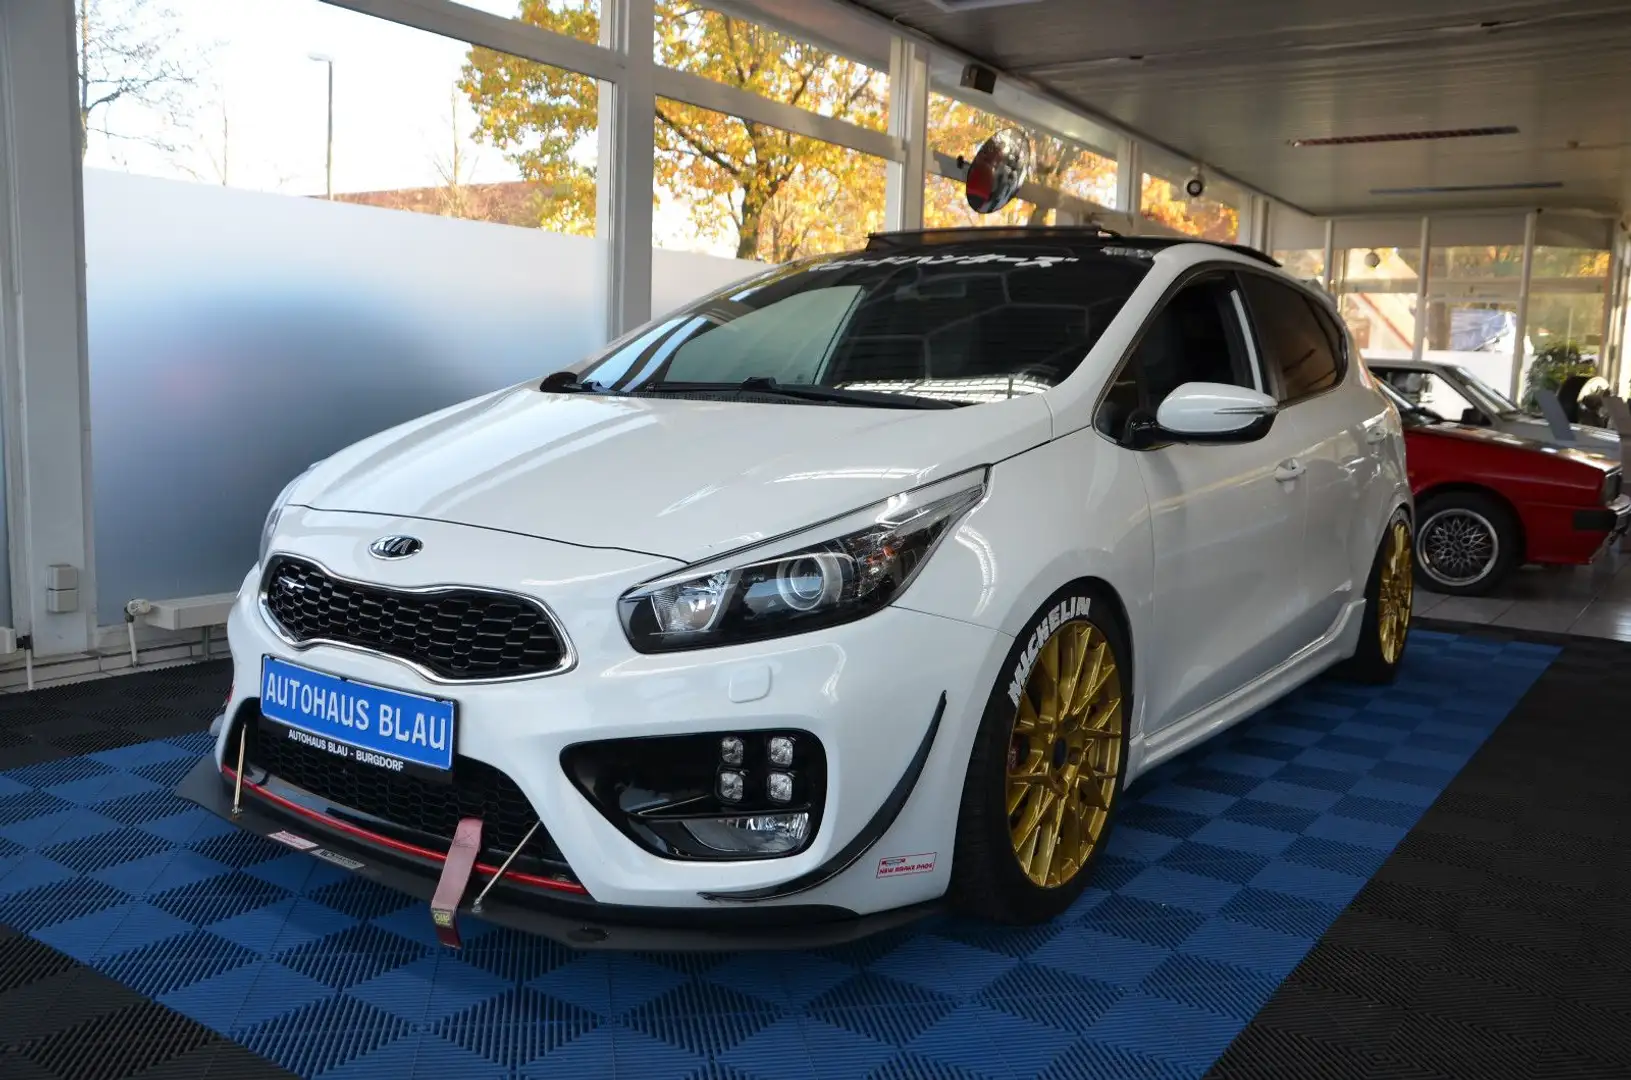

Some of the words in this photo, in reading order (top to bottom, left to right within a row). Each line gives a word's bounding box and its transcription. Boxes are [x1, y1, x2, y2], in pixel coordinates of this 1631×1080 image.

[372, 536, 413, 554] KIA
[1007, 596, 1091, 708] MICHELIN
[265, 672, 370, 731] AUTOHAUS
[378, 703, 447, 750] BLAU
[288, 729, 326, 750] AUTOHAUS
[328, 741, 348, 757] BLAU
[356, 751, 404, 771] BURGDORF
